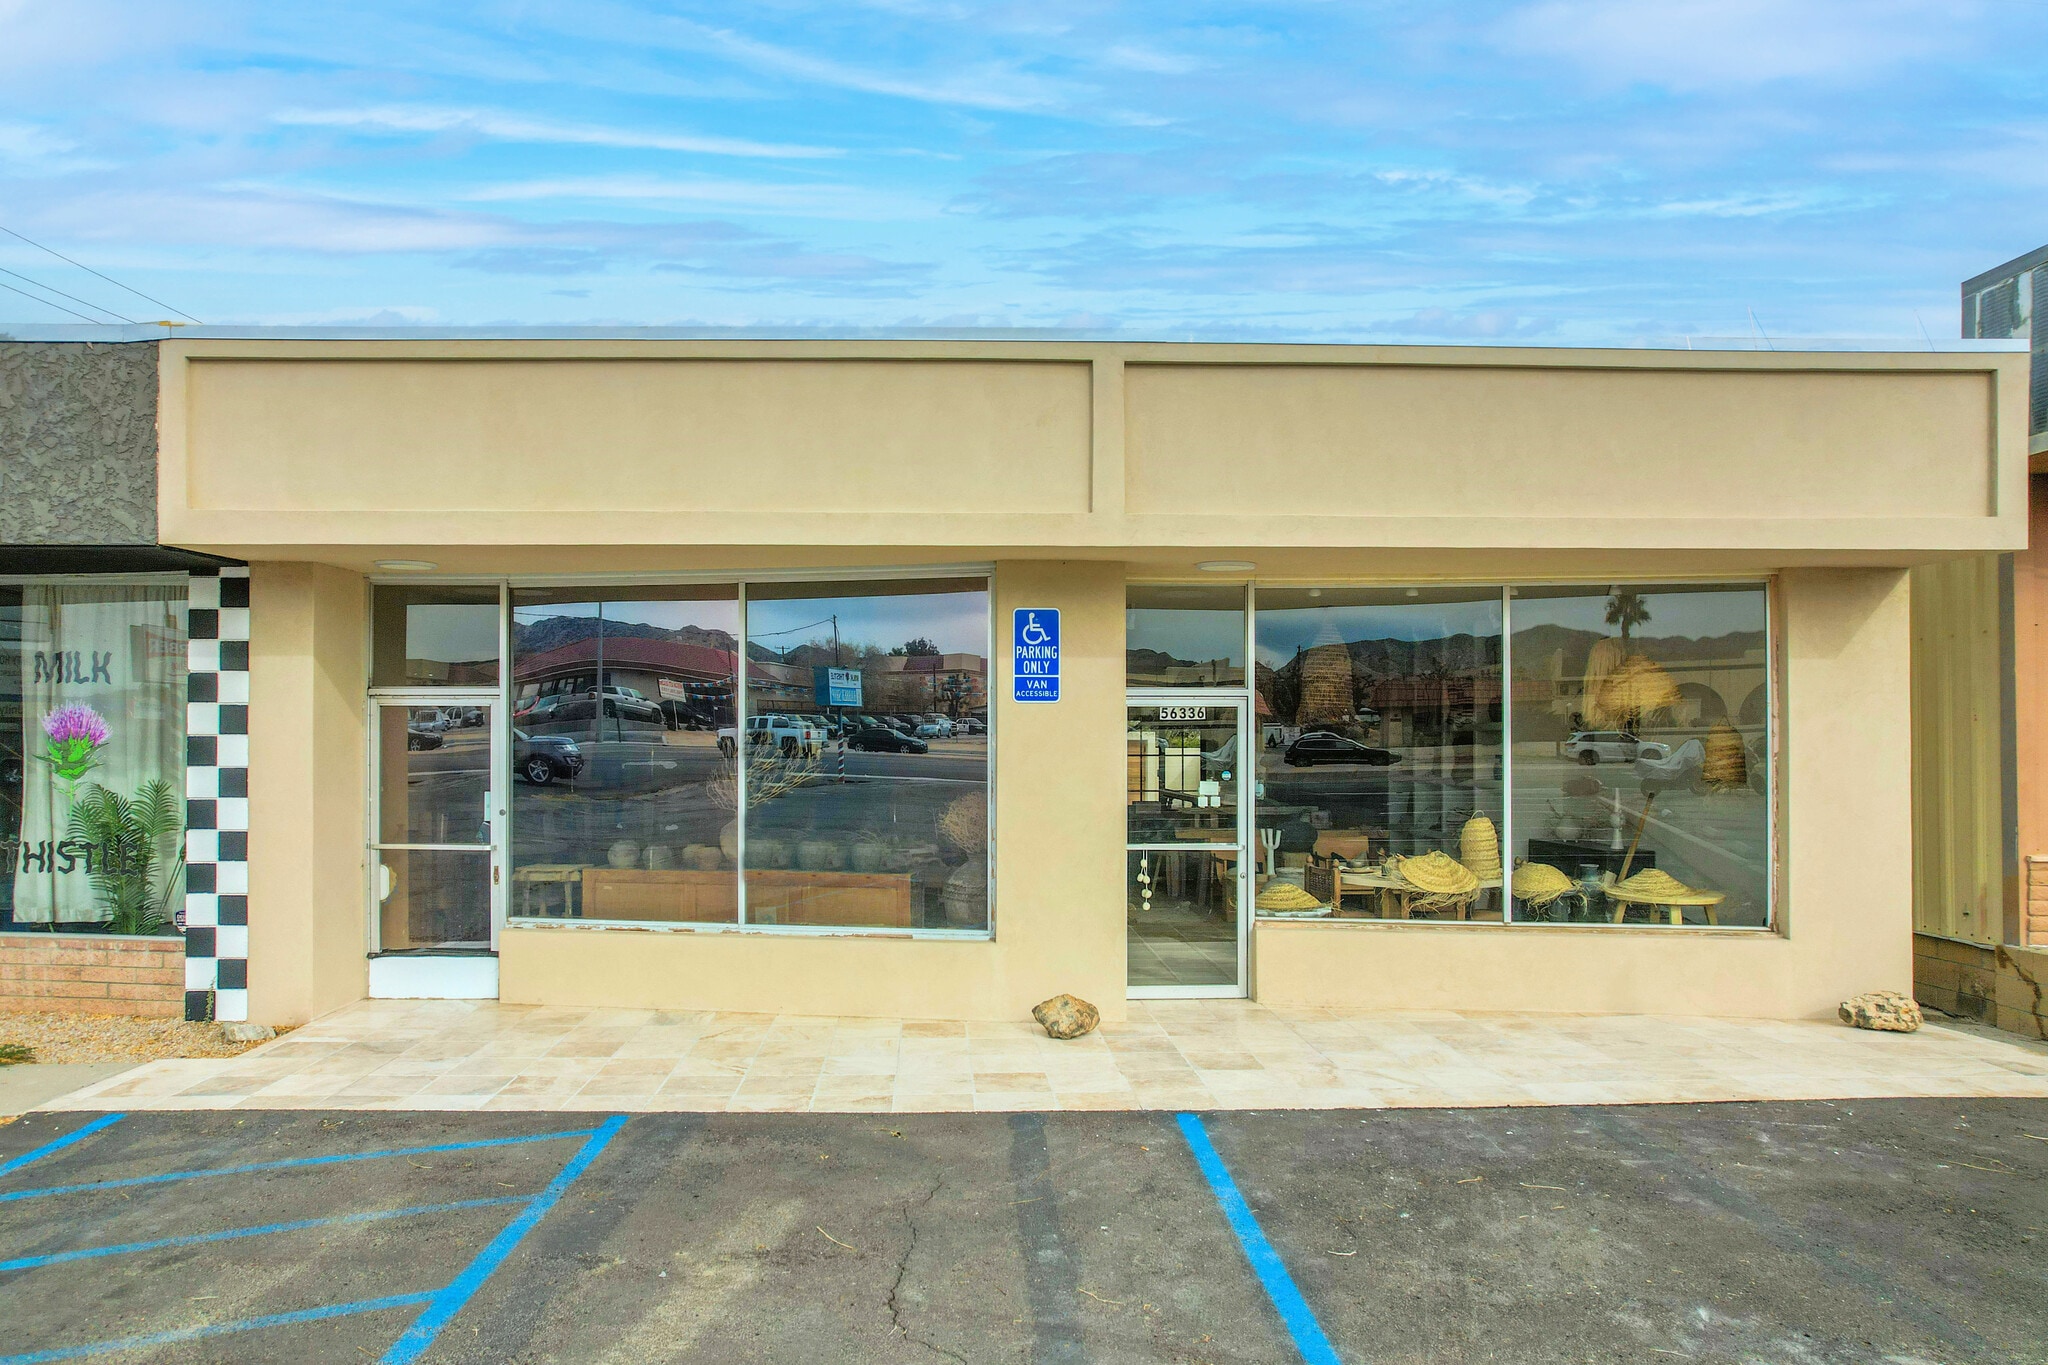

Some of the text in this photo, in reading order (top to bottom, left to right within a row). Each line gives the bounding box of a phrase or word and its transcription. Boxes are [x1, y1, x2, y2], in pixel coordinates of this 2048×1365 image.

[1016, 646, 1057, 659] PARKING
[34, 650, 112, 685] MILK
[1023, 660, 1050, 674] ONLY
[1026, 680, 1048, 689] VAN
[1161, 707, 1205, 719] 56336
[0, 840, 139, 877] THISTLE
